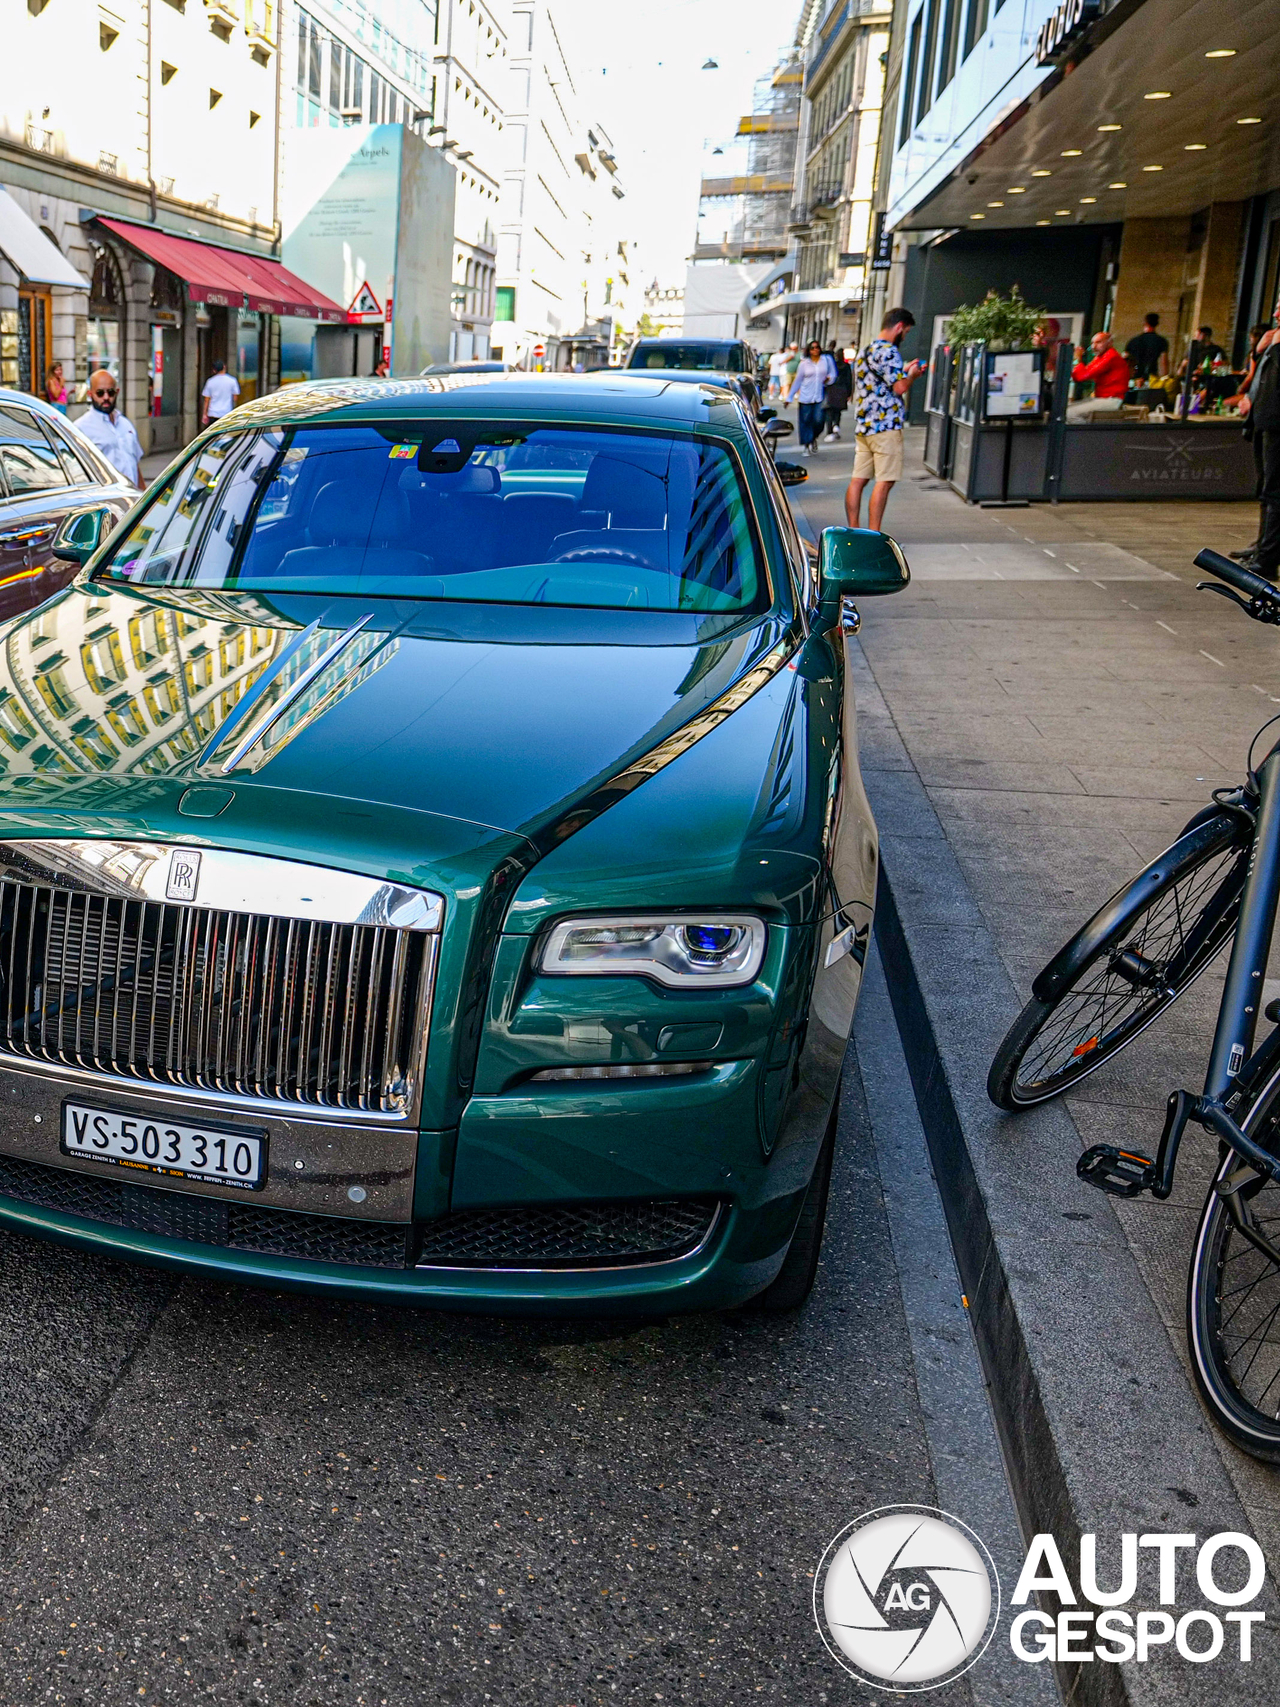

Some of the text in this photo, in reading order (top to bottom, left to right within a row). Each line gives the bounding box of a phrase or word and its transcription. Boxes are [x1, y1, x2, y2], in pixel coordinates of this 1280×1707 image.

[1130, 468, 1222, 480] AVIATEURS
[70, 1150, 91, 1159] GARAGE
[119, 1160, 149, 1171] LAUSANNE
[169, 1169, 184, 1177] SION
